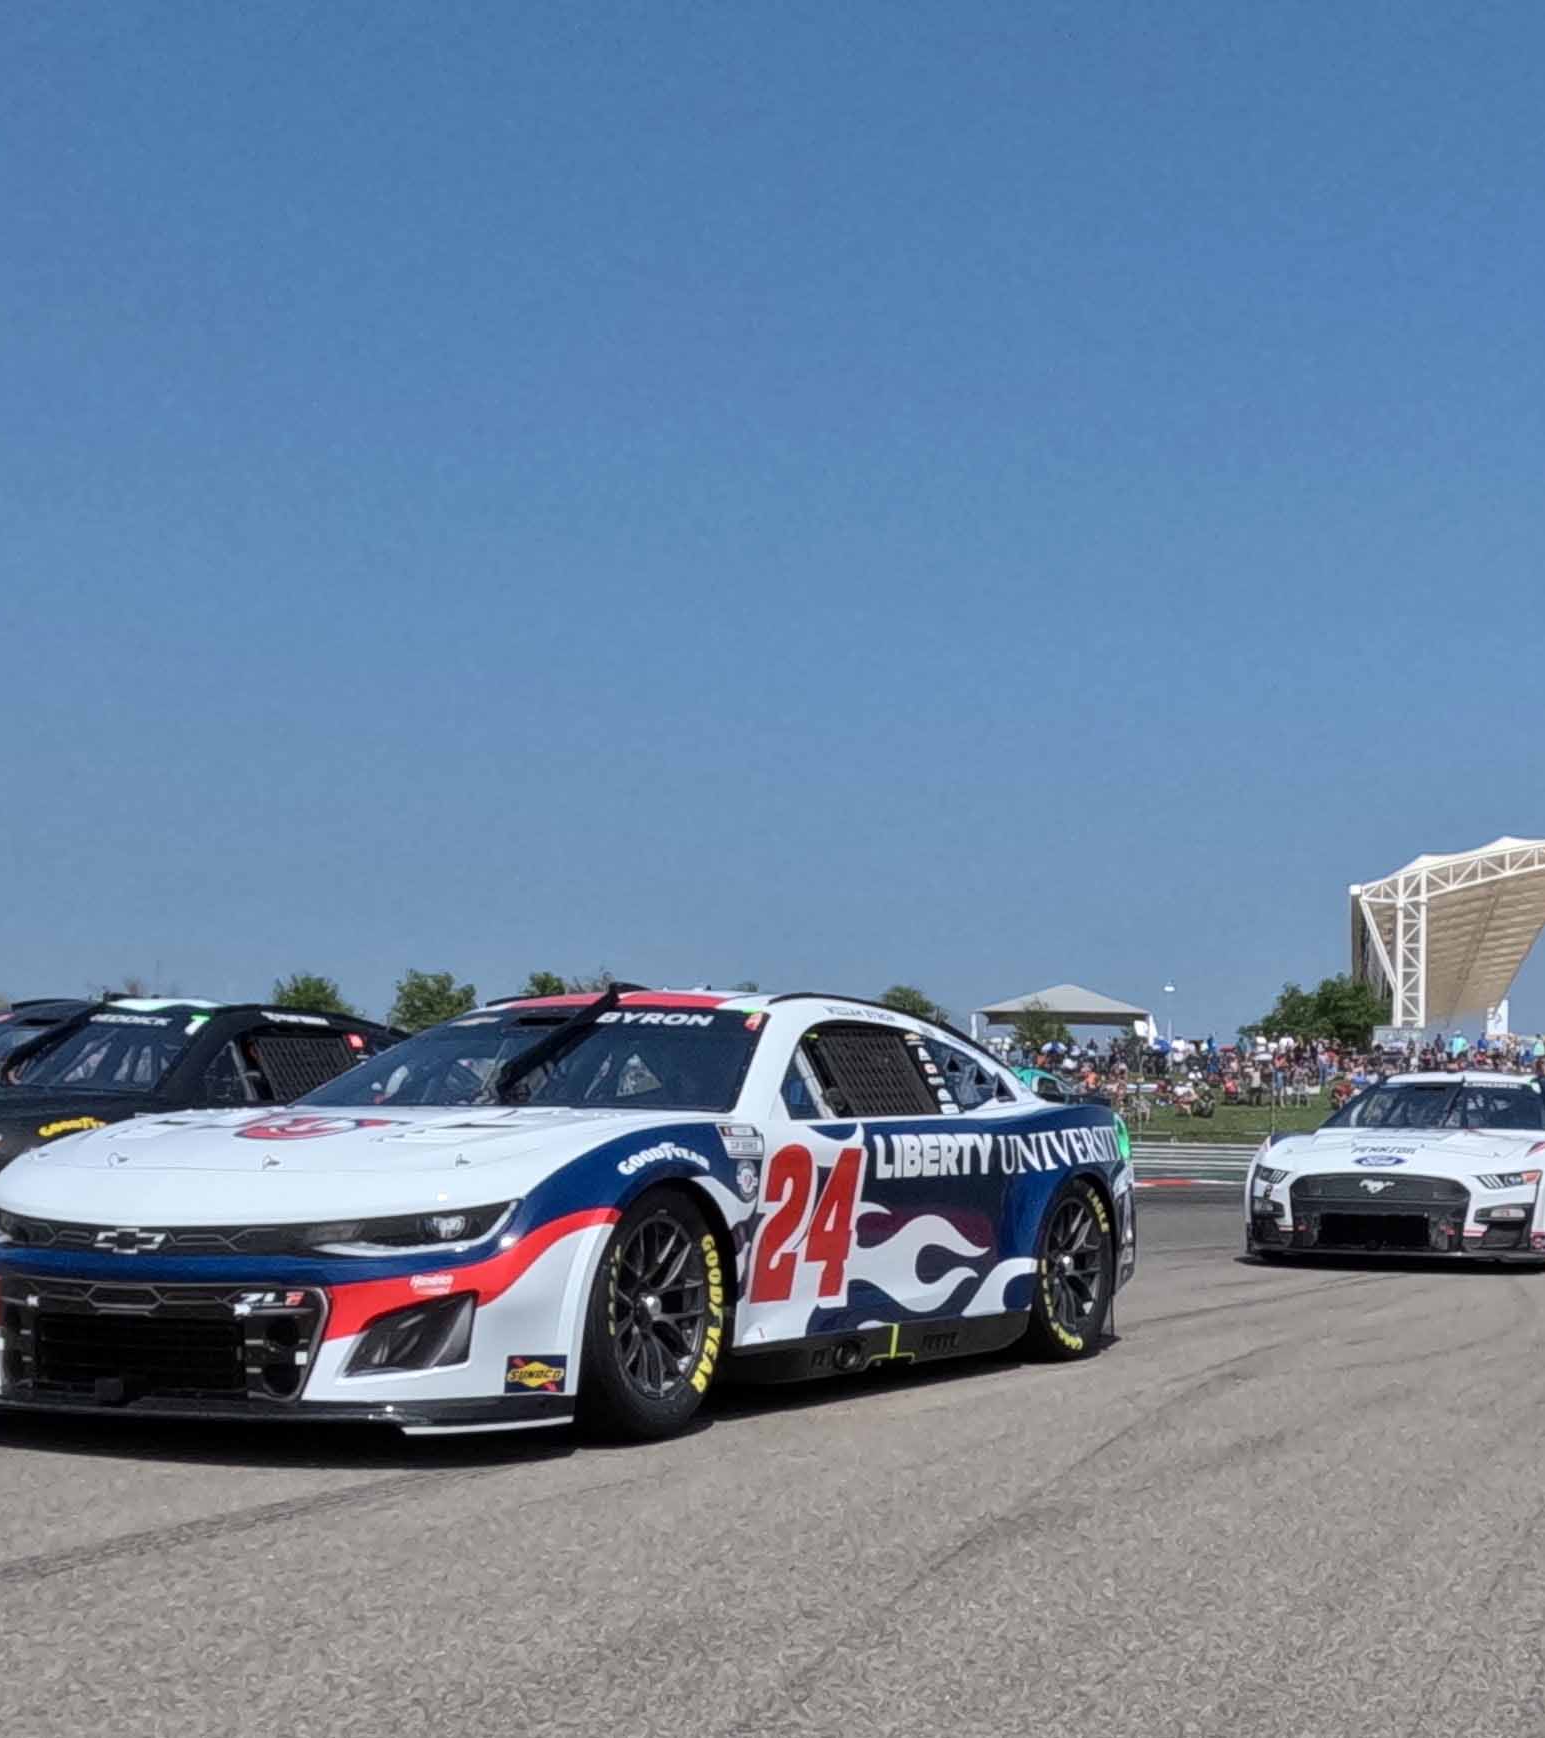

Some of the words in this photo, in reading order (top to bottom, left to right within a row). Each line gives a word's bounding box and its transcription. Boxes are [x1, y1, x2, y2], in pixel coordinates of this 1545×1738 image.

[595, 1011, 715, 1027] BYRON
[616, 1141, 711, 1176] GOODYEAR
[872, 1133, 993, 1180] LIBERTY
[747, 1142, 865, 1306] 24
[509, 1368, 564, 1382] SUNOCO
